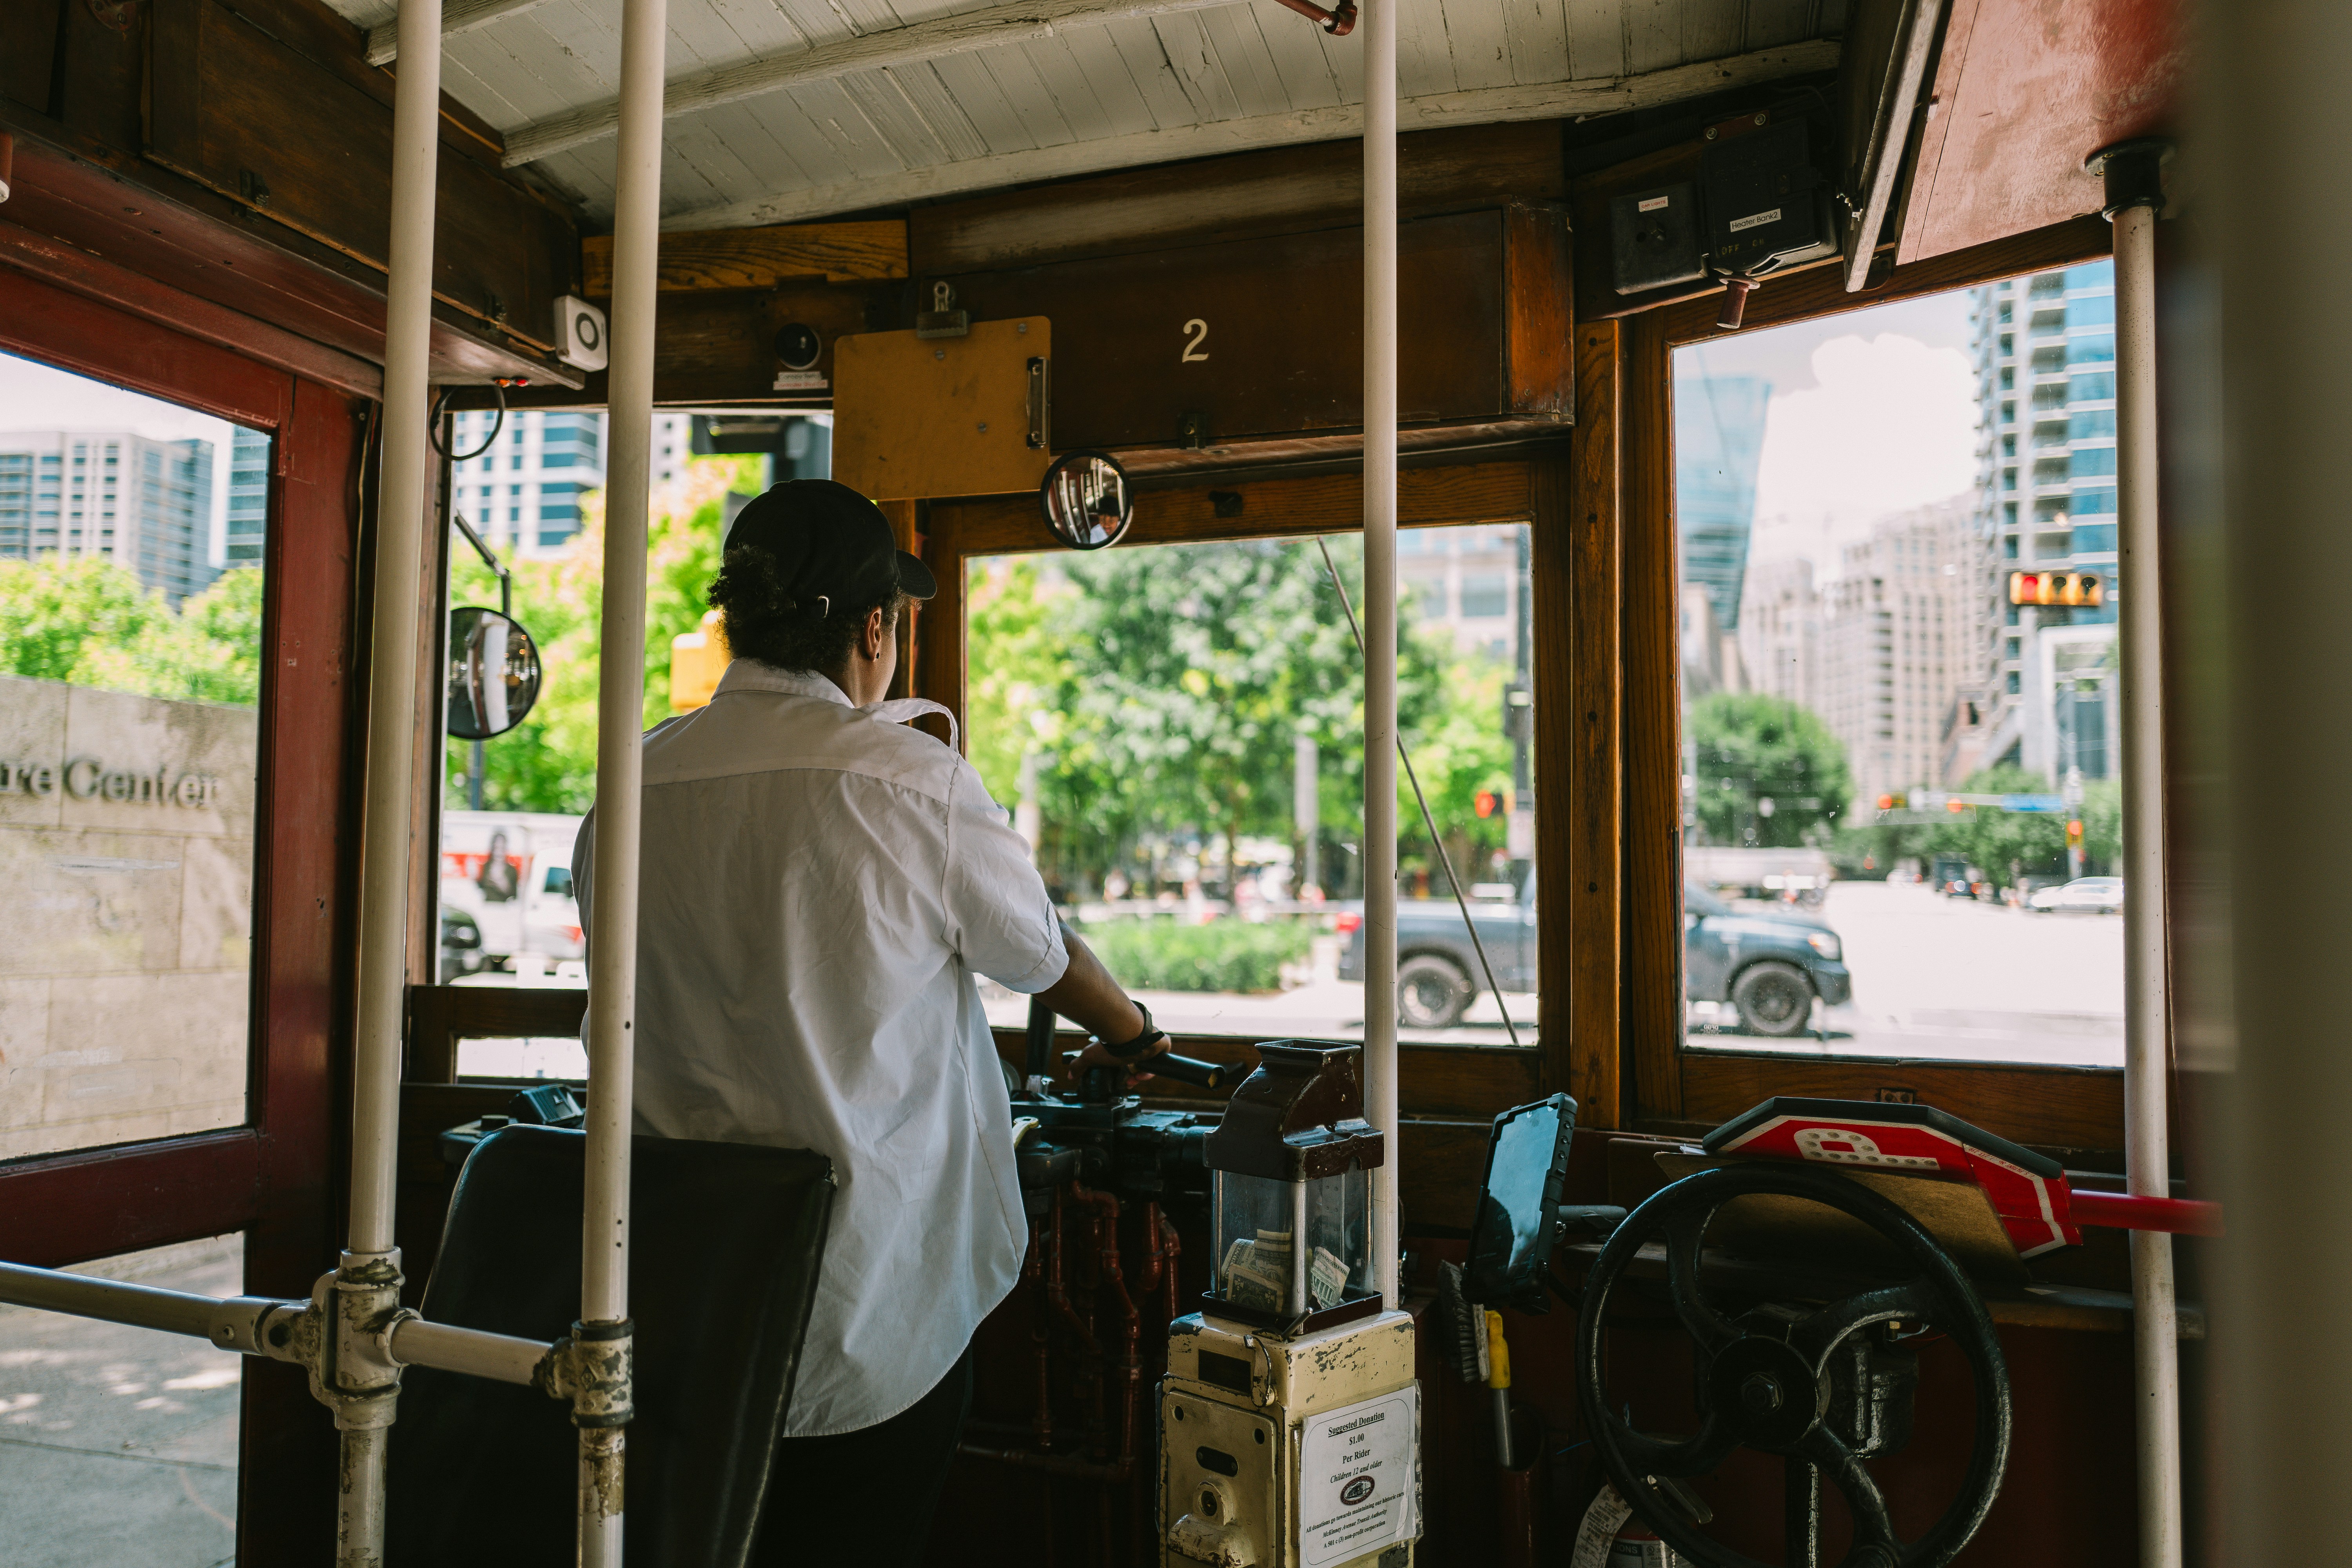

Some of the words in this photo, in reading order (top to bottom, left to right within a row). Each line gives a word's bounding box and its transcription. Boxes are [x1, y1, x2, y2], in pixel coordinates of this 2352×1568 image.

[1731, 218, 1755, 229] Heater
[1757, 211, 1778, 223] Bank2
[1721, 243, 1740, 255] OFF
[1182, 318, 1209, 363] 2
[64, 758, 220, 810] Center
[1328, 1419, 1357, 1436] Suggested
[1359, 1412, 1385, 1426] Donation
[1349, 1433, 1364, 1445] $1.00
[1342, 1455, 1353, 1464] Per
[1354, 1449, 1371, 1460] Rider
[1330, 1471, 1352, 1483] Children
[1353, 1467, 1359, 1476] 12
[1359, 1463, 1369, 1473] and
[1370, 1460, 1383, 1470] older
[1312, 1520, 1330, 1530] donations
[1336, 1512, 1352, 1522] towards
[1352, 1503, 1374, 1515] maintaining
[1382, 1494, 1396, 1504] historic
[1323, 1527, 1342, 1538] McKinney
[1342, 1522, 1356, 1531] Avenue
[1357, 1515, 1370, 1525] Transit
[1370, 1509, 1387, 1520] Authority
[1344, 1529, 1363, 1540] non-profit
[1364, 1520, 1385, 1532] corporation
